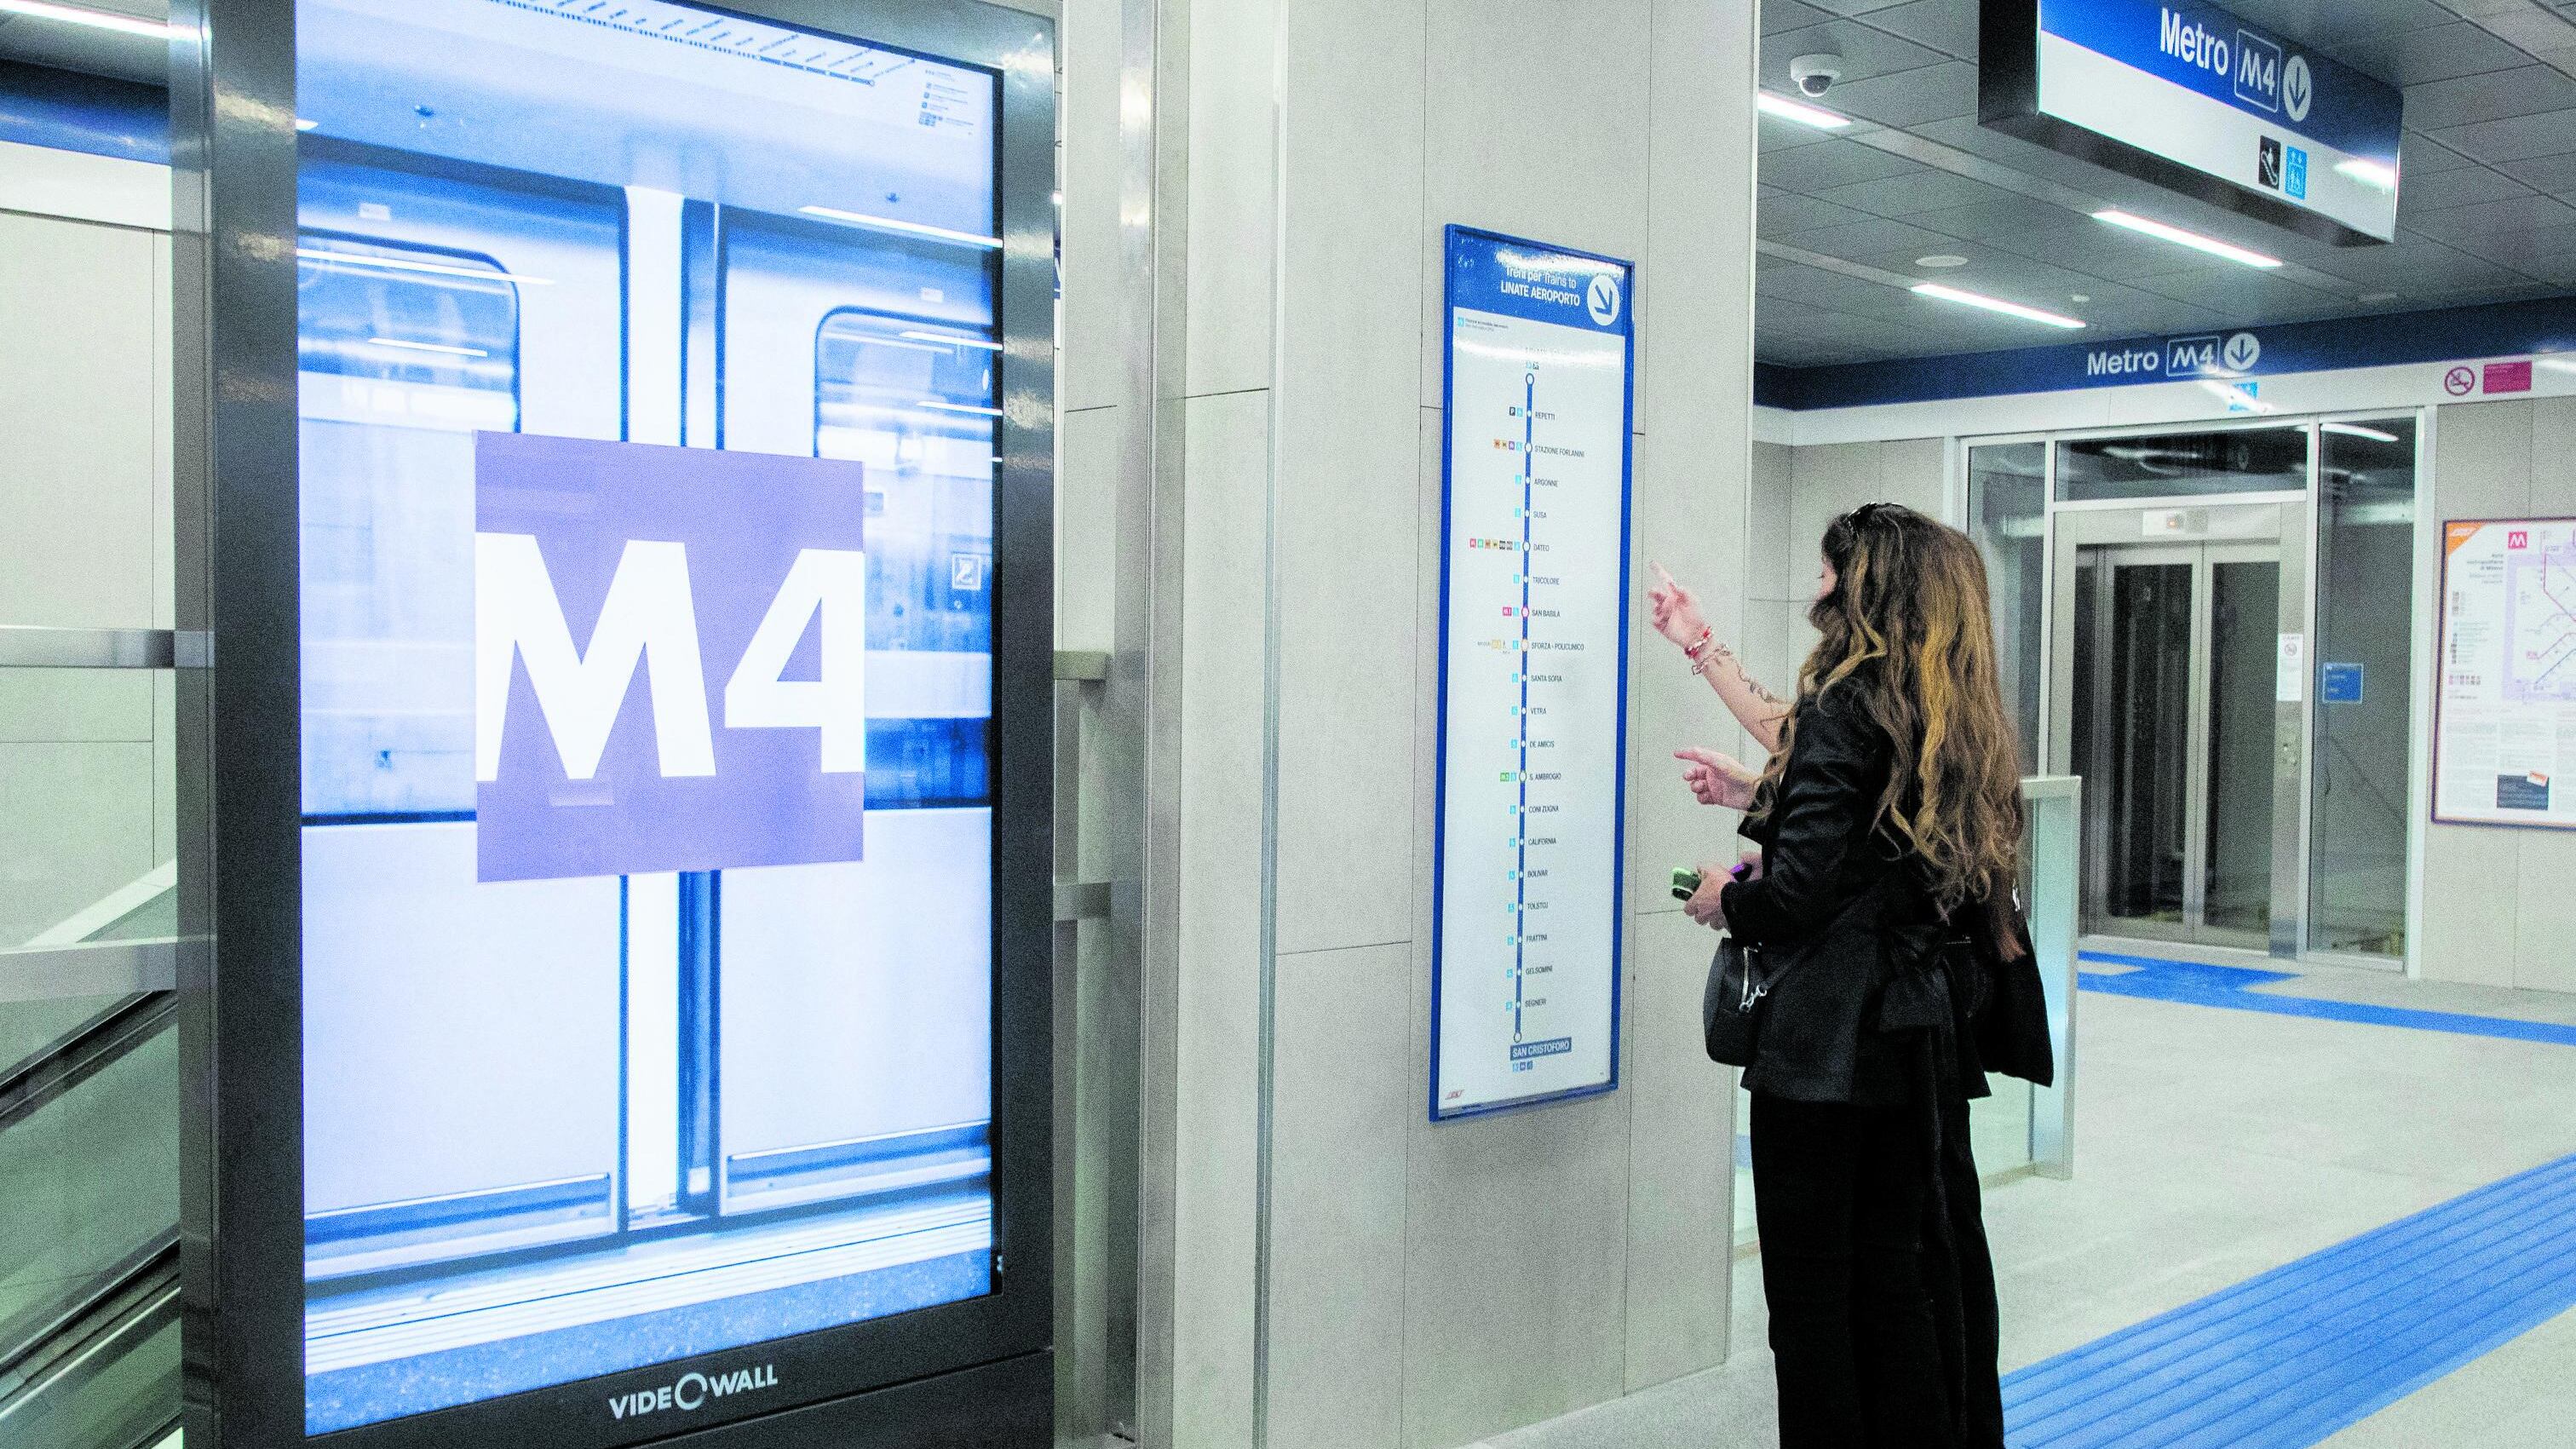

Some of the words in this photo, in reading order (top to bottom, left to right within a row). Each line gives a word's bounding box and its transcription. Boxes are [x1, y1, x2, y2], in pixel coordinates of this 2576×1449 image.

[2159, 8, 2228, 77] Metro
[2240, 49, 2276, 95] M4
[1527, 272, 1542, 282] per
[1544, 272, 1567, 288] Trains
[1568, 277, 1577, 289] to
[1500, 280, 1530, 297] LINATE
[1530, 286, 1580, 307] AEROPORTO
[2087, 350, 2159, 376] Metro
[2172, 343, 2214, 368] M4
[1534, 411, 1555, 421] REPETTI
[1534, 446, 1559, 455] STAZIONE
[1533, 543, 1550, 552] DATEO
[2509, 535, 2527, 547] M
[1532, 577, 1560, 585] TRICOLORE
[475, 532, 865, 782] M4
[1528, 837, 1556, 846] CALIFORNIA
[1512, 1046, 1527, 1058] SAN
[1527, 1041, 1569, 1056] CRISTOFORO
[608, 1364, 779, 1420] VIDEOWALL
